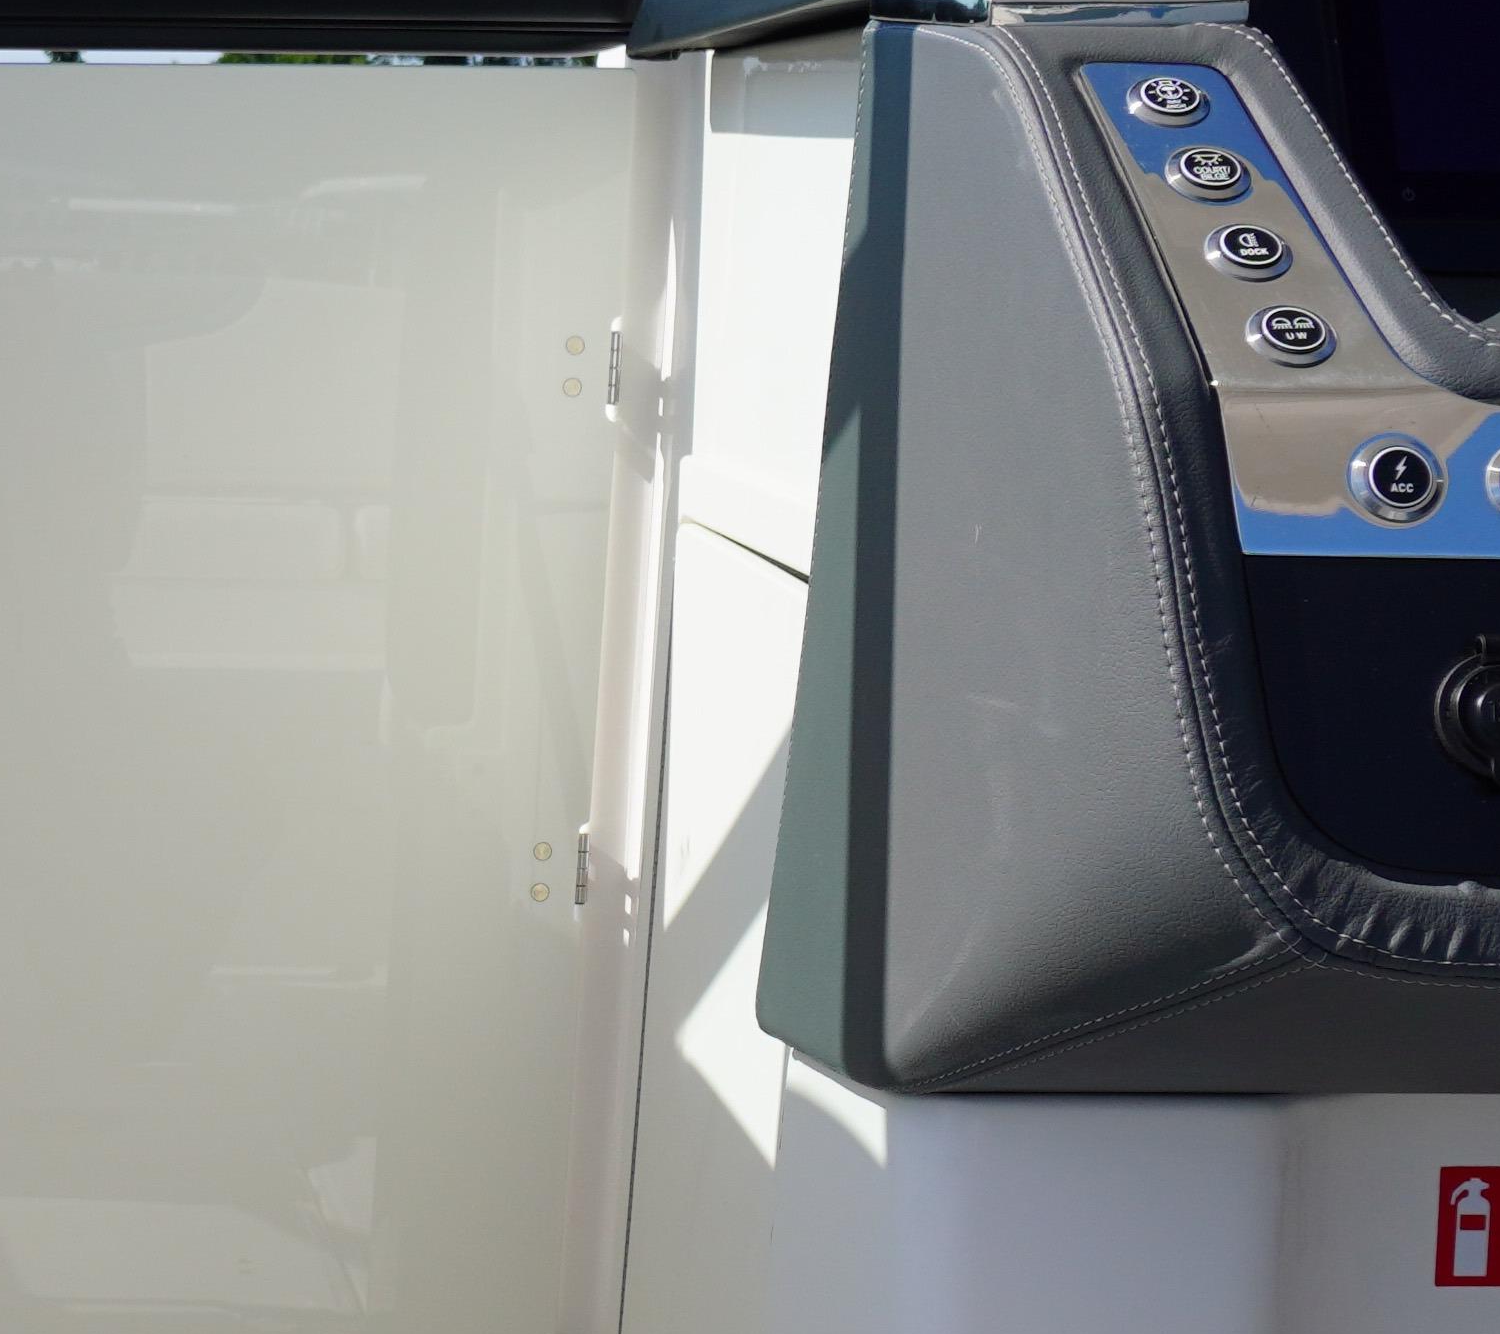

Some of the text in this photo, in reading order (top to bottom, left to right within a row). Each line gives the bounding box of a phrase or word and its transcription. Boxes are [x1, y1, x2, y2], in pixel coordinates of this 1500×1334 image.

[1193, 165, 1230, 176] COURT/
[1240, 247, 1269, 256] DOCK
[1390, 482, 1414, 493] ACC
